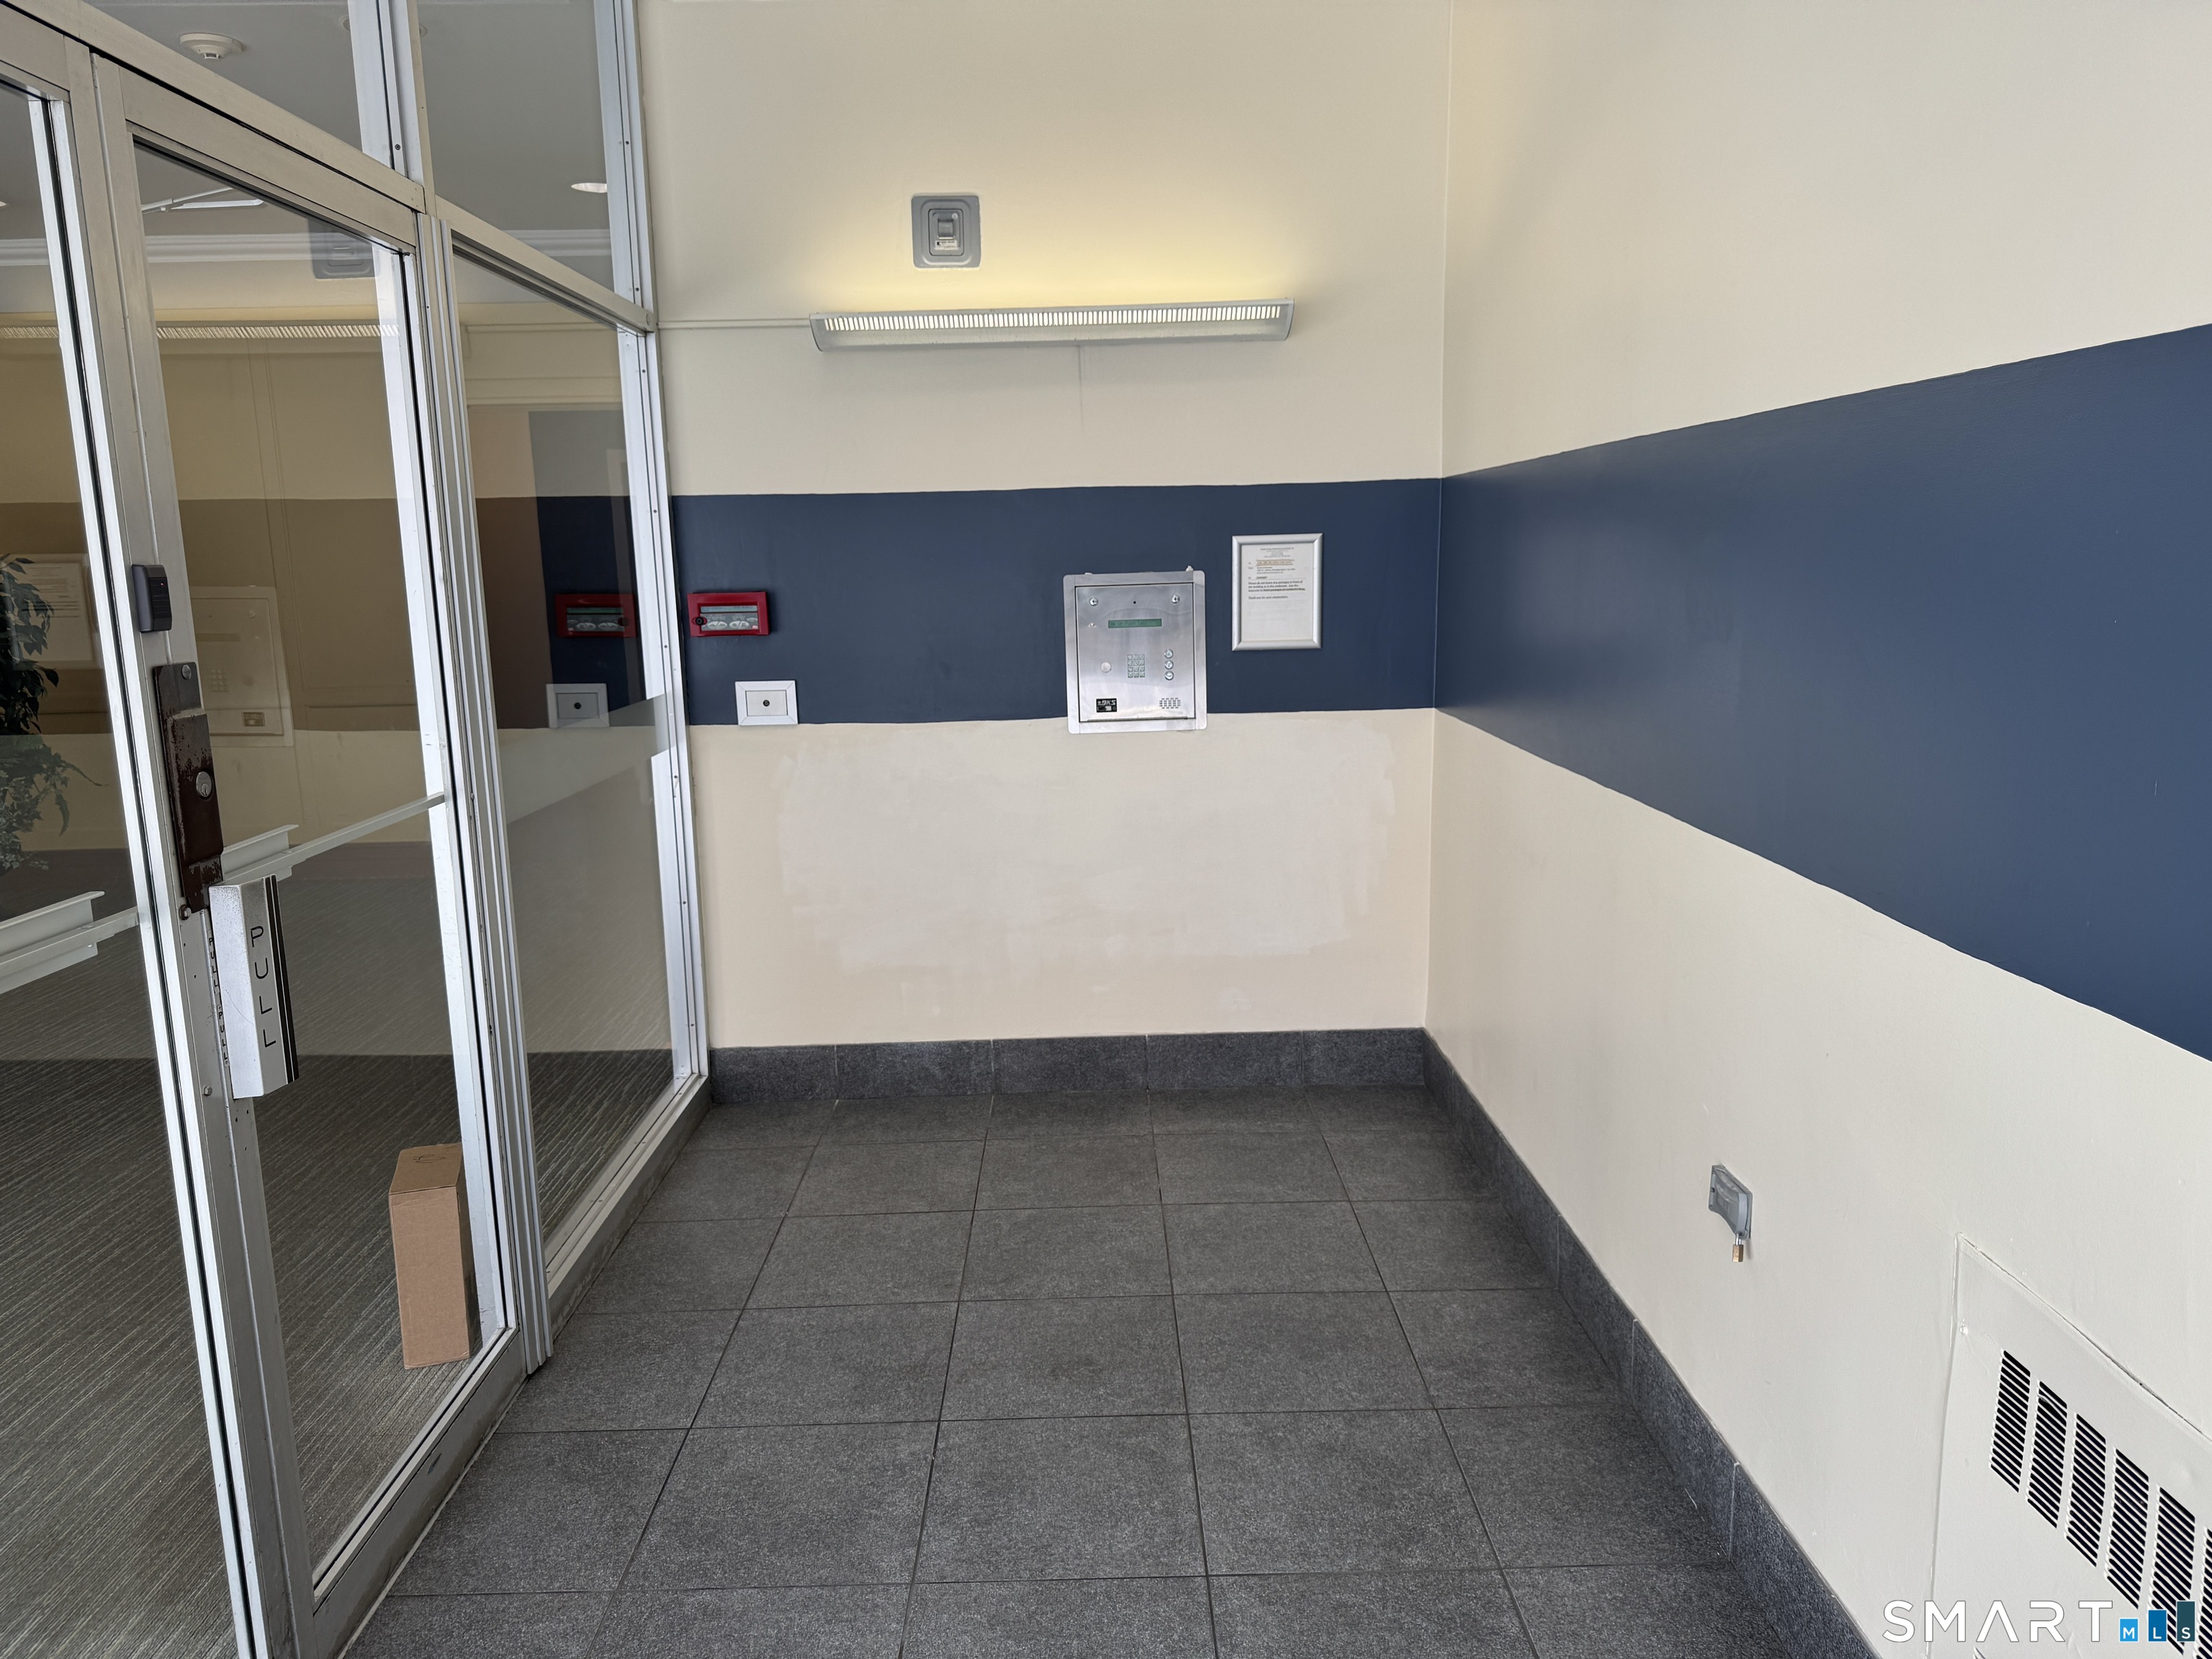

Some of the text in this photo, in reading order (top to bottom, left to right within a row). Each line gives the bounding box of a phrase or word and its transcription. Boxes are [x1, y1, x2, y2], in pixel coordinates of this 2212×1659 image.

[209, 938, 218, 987] PULL
[251, 925, 276, 1048] PULL
[218, 1012, 228, 1061] PULL
